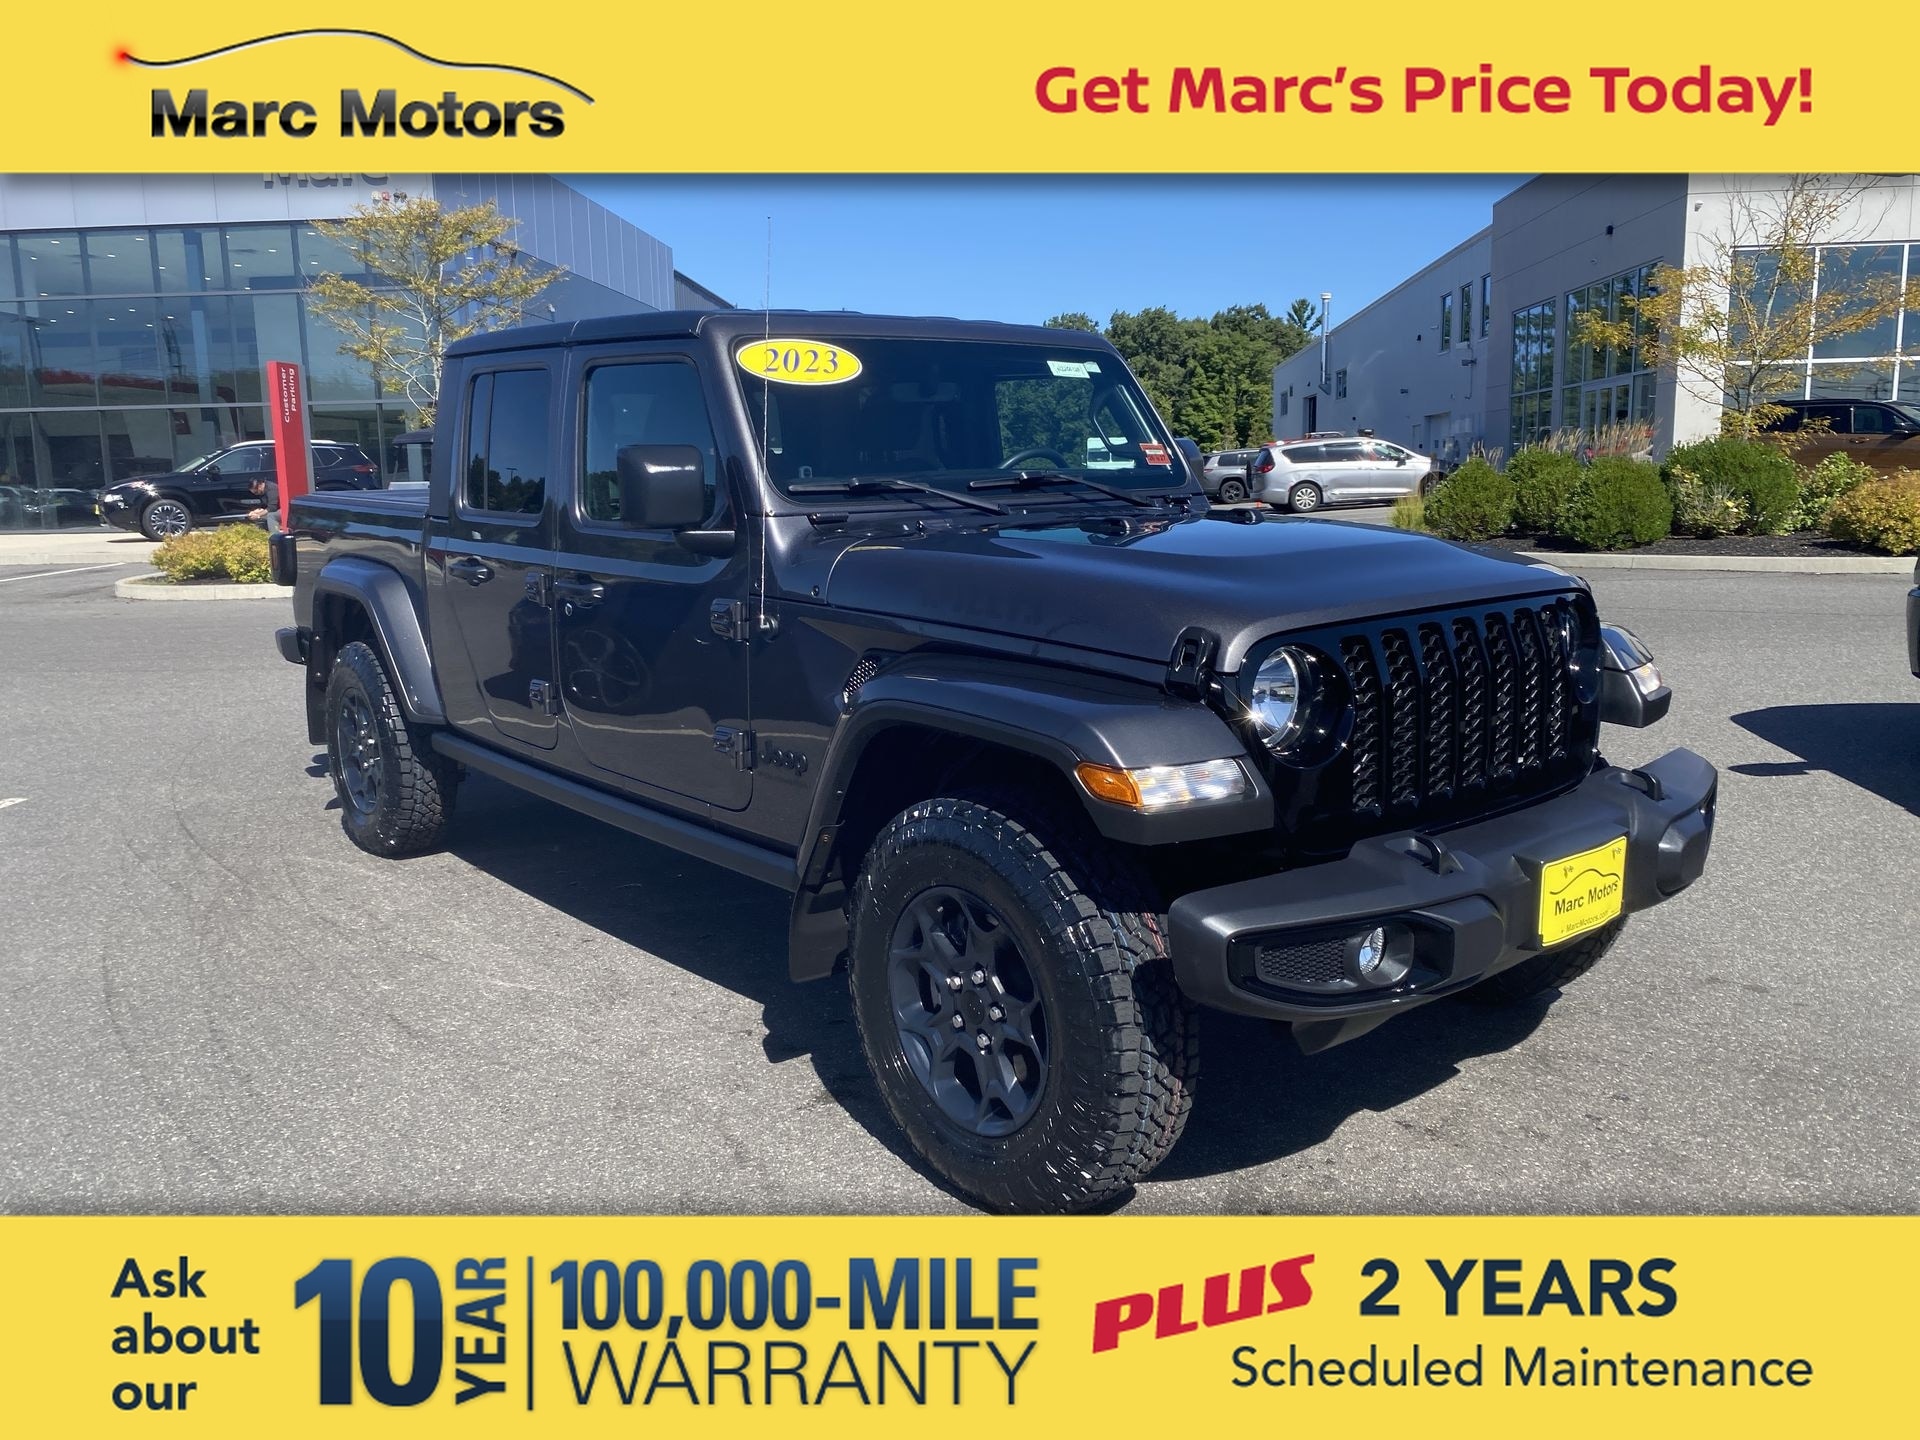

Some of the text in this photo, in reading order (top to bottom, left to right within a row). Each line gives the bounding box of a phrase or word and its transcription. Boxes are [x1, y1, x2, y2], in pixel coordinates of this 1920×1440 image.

[764, 348, 838, 373] 2023
[280, 367, 290, 423] Customer
[289, 368, 297, 412] Parking
[1554, 880, 1618, 916] Marc Motors
